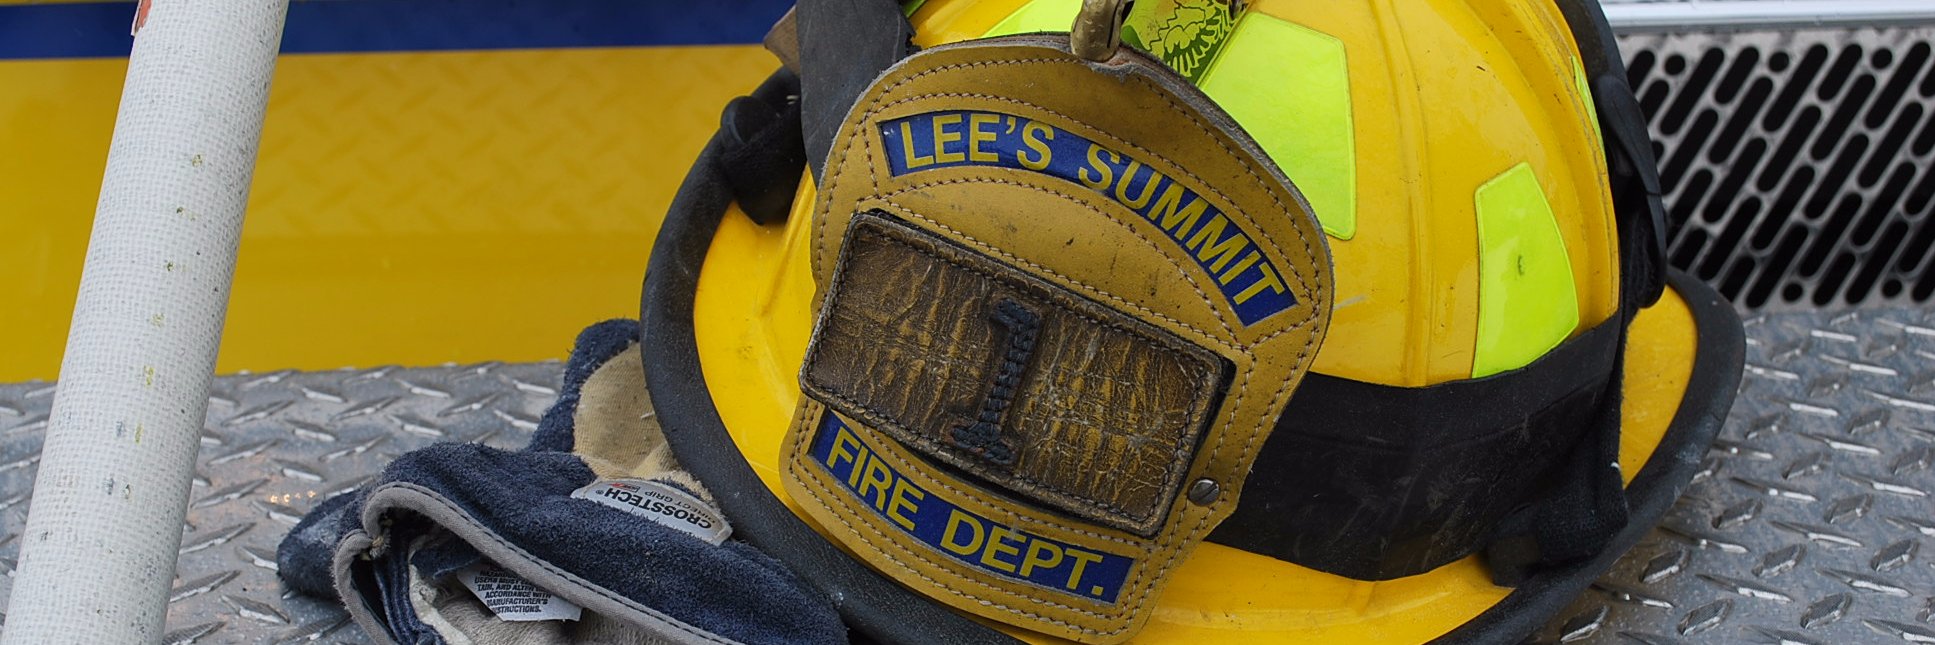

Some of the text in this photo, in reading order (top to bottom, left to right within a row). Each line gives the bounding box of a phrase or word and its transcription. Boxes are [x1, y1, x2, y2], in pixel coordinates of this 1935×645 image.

[900, 113, 1285, 306] LEE'S SUMMIT
[951, 298, 1040, 465] 1
[645, 491, 673, 503] GRIP
[826, 426, 1105, 596] FIRE DEPT.
[485, 591, 532, 599] ACCORDANCE
